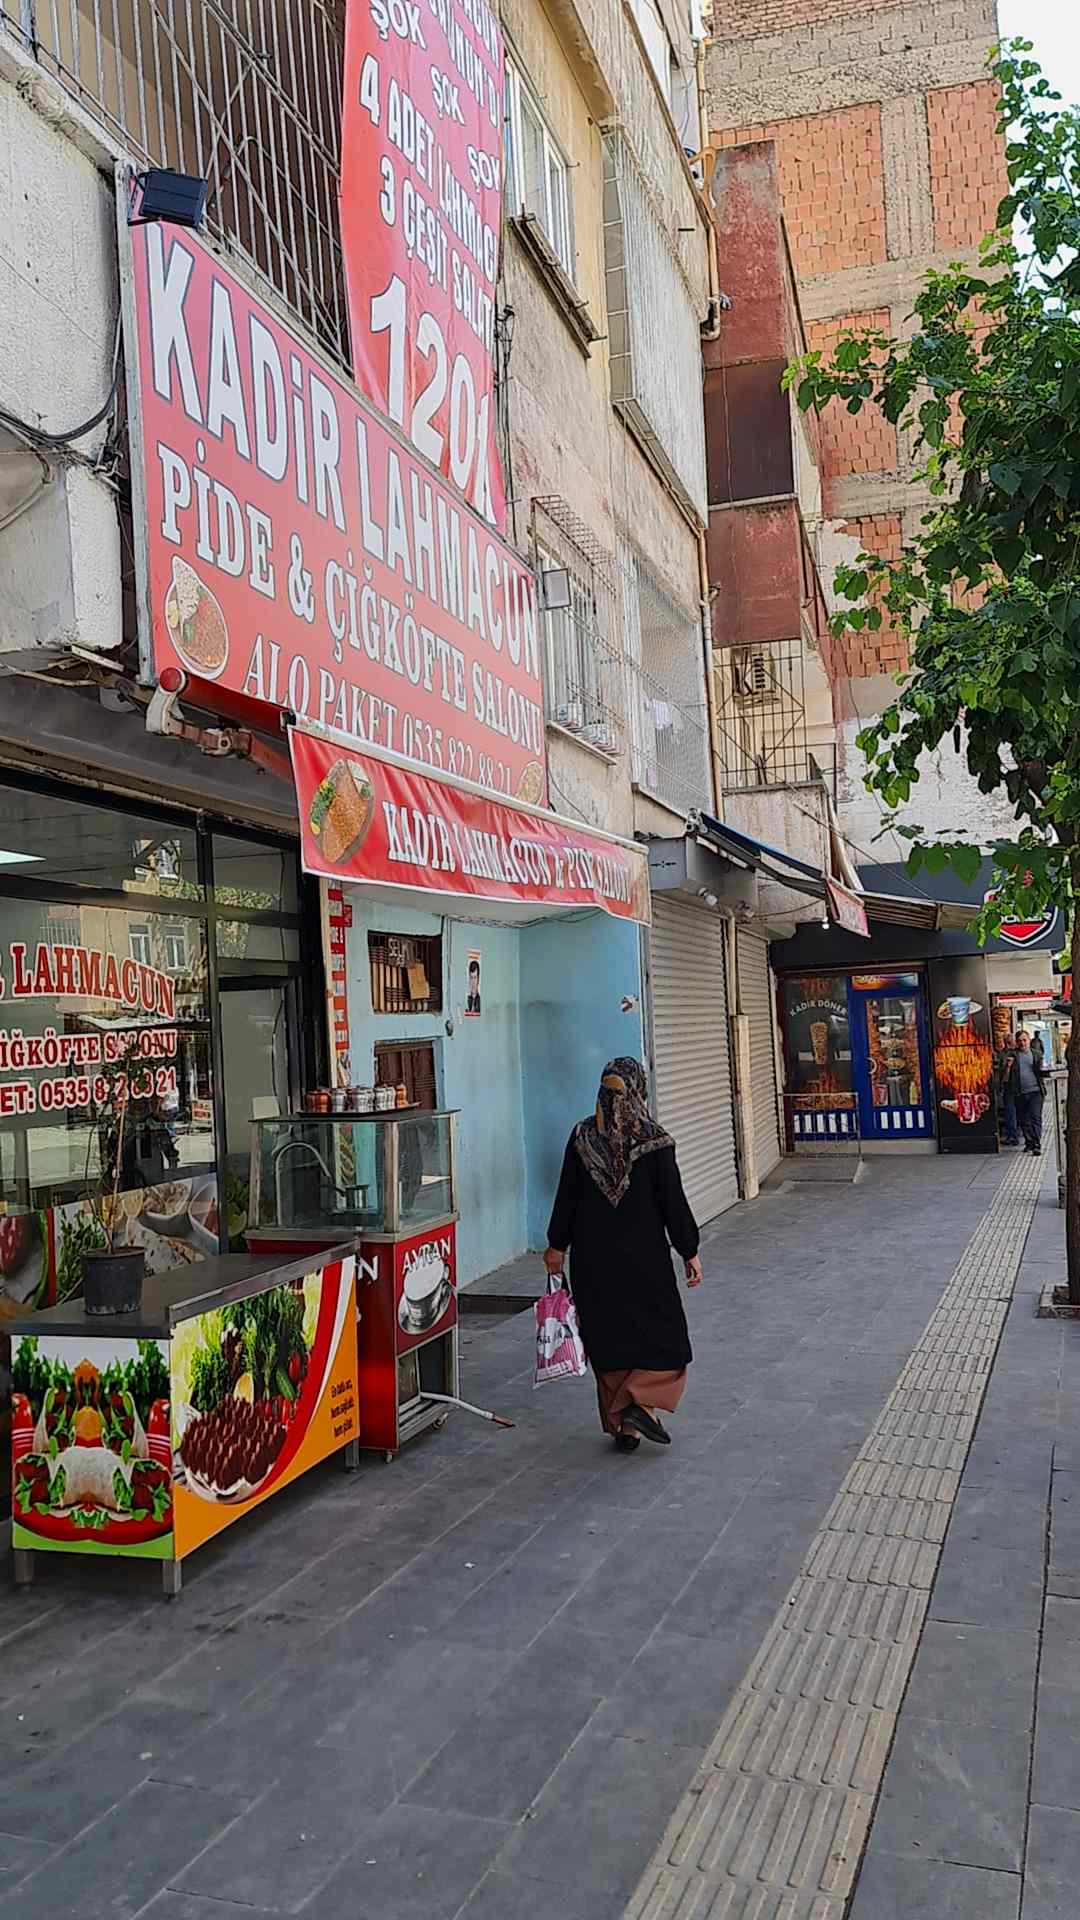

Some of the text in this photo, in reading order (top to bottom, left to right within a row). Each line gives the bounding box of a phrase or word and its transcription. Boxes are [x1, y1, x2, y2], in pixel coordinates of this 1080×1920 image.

[360, 53, 497, 284] 4 ADET LAHMAC
[379, 154, 397, 227] 3
[355, 416, 540, 681] LAHMACUN
[156, 440, 542, 756] PİDE & ÇİĞKÖFTE SALONU
[240, 633, 310, 715] ALO
[11, 944, 176, 1018] LAHMACUN
[41, 1079, 89, 1110] 0535
[157, 1067, 175, 1094] 21
[402, 1236, 451, 1276] AYRAN
